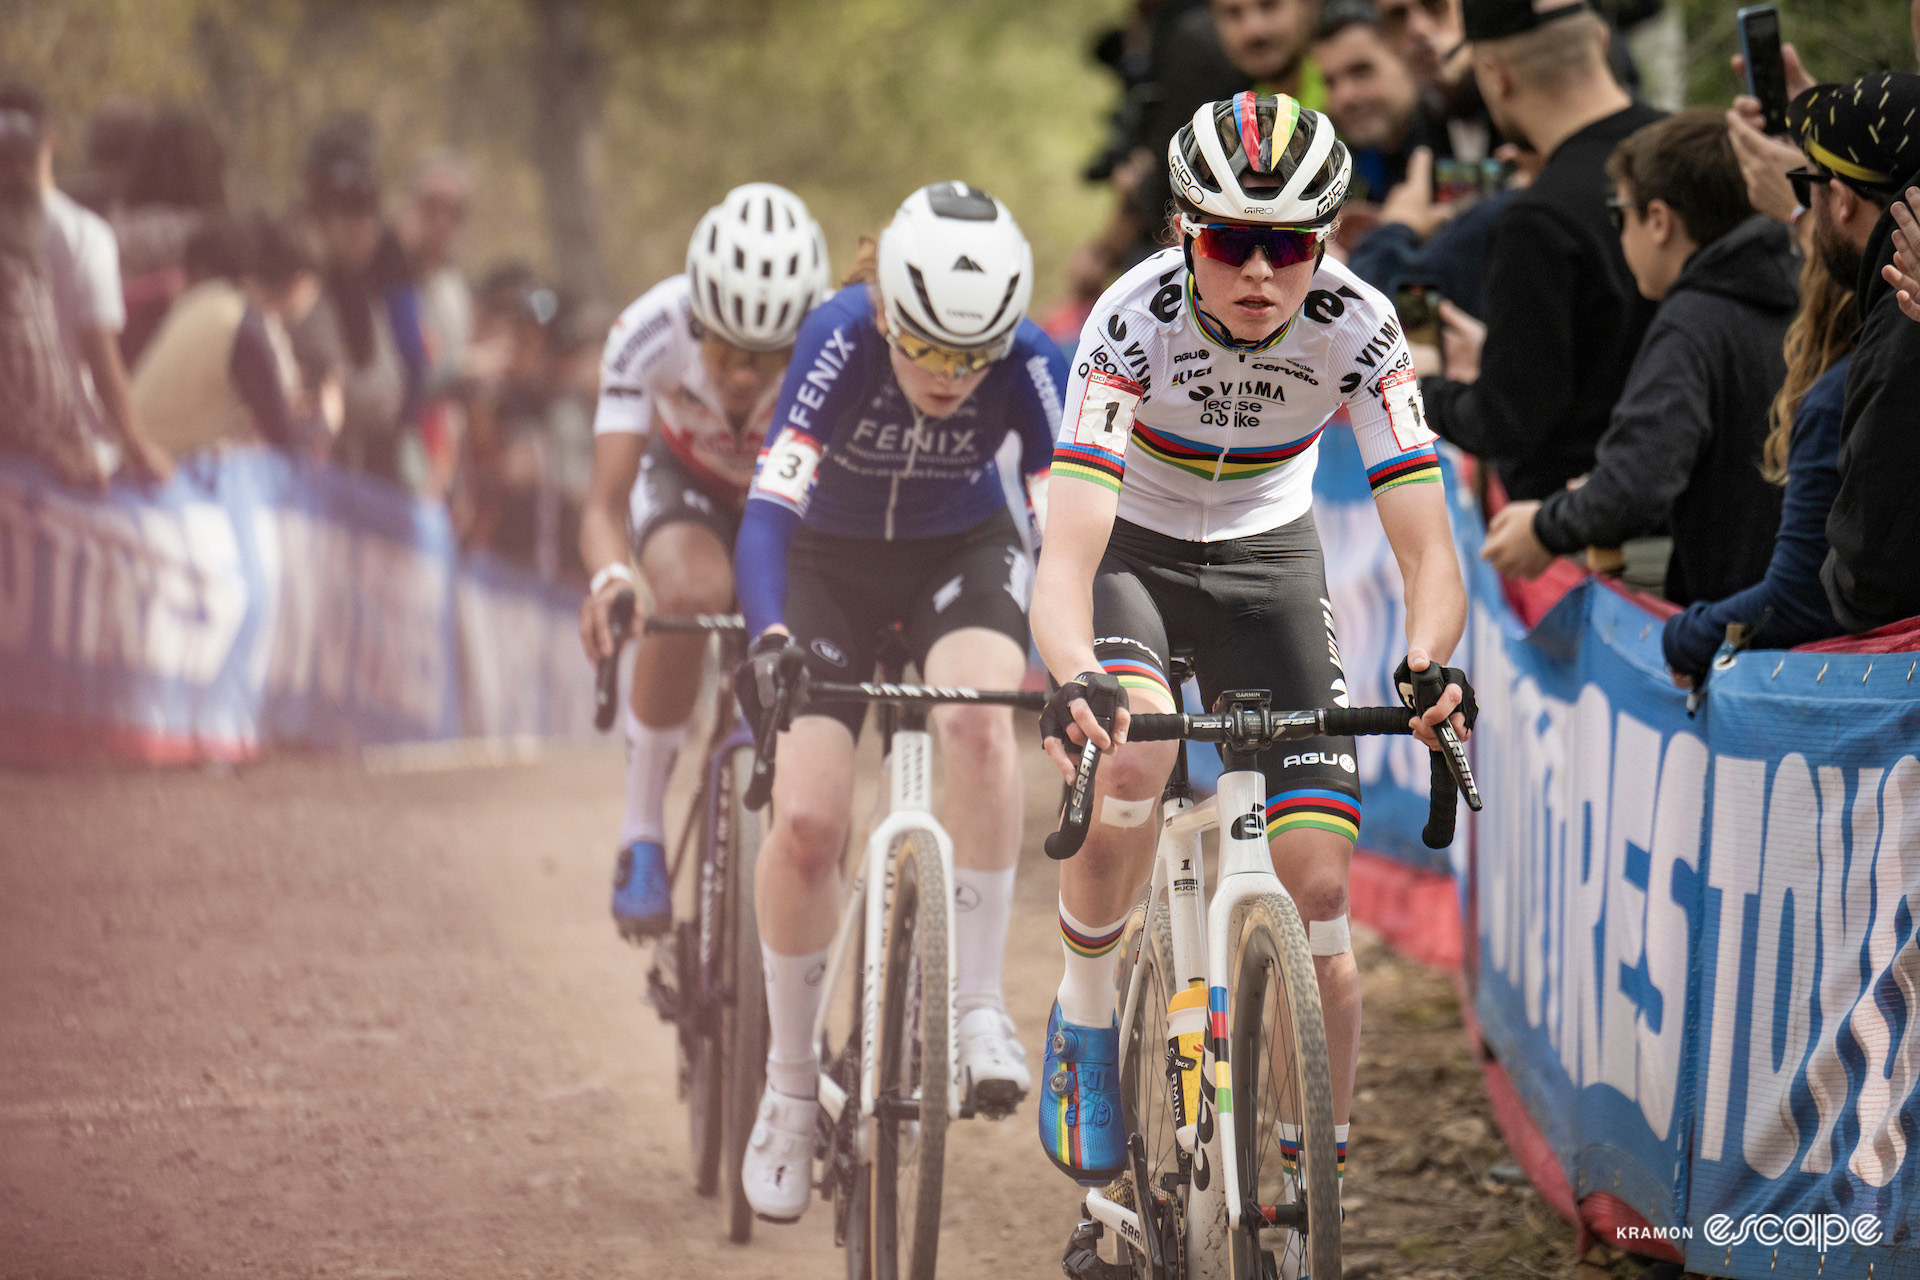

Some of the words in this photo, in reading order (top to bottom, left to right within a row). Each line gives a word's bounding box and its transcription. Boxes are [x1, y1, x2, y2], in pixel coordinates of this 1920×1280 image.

[1170, 155, 1204, 204] GIRO
[1316, 168, 1350, 217] GIRO
[1244, 206, 1275, 215] GIRO
[1174, 351, 1197, 364] AGU
[788, 328, 856, 430] FENIX
[1220, 381, 1286, 402] VISMA
[1105, 401, 1120, 433] 1
[852, 418, 976, 455] FENIX
[779, 454, 802, 479] 3
[1072, 738, 1097, 809] SRAM
[1283, 752, 1338, 769] AGU
[1441, 727, 1478, 795] SRAM
[1181, 859, 1191, 870] 1
